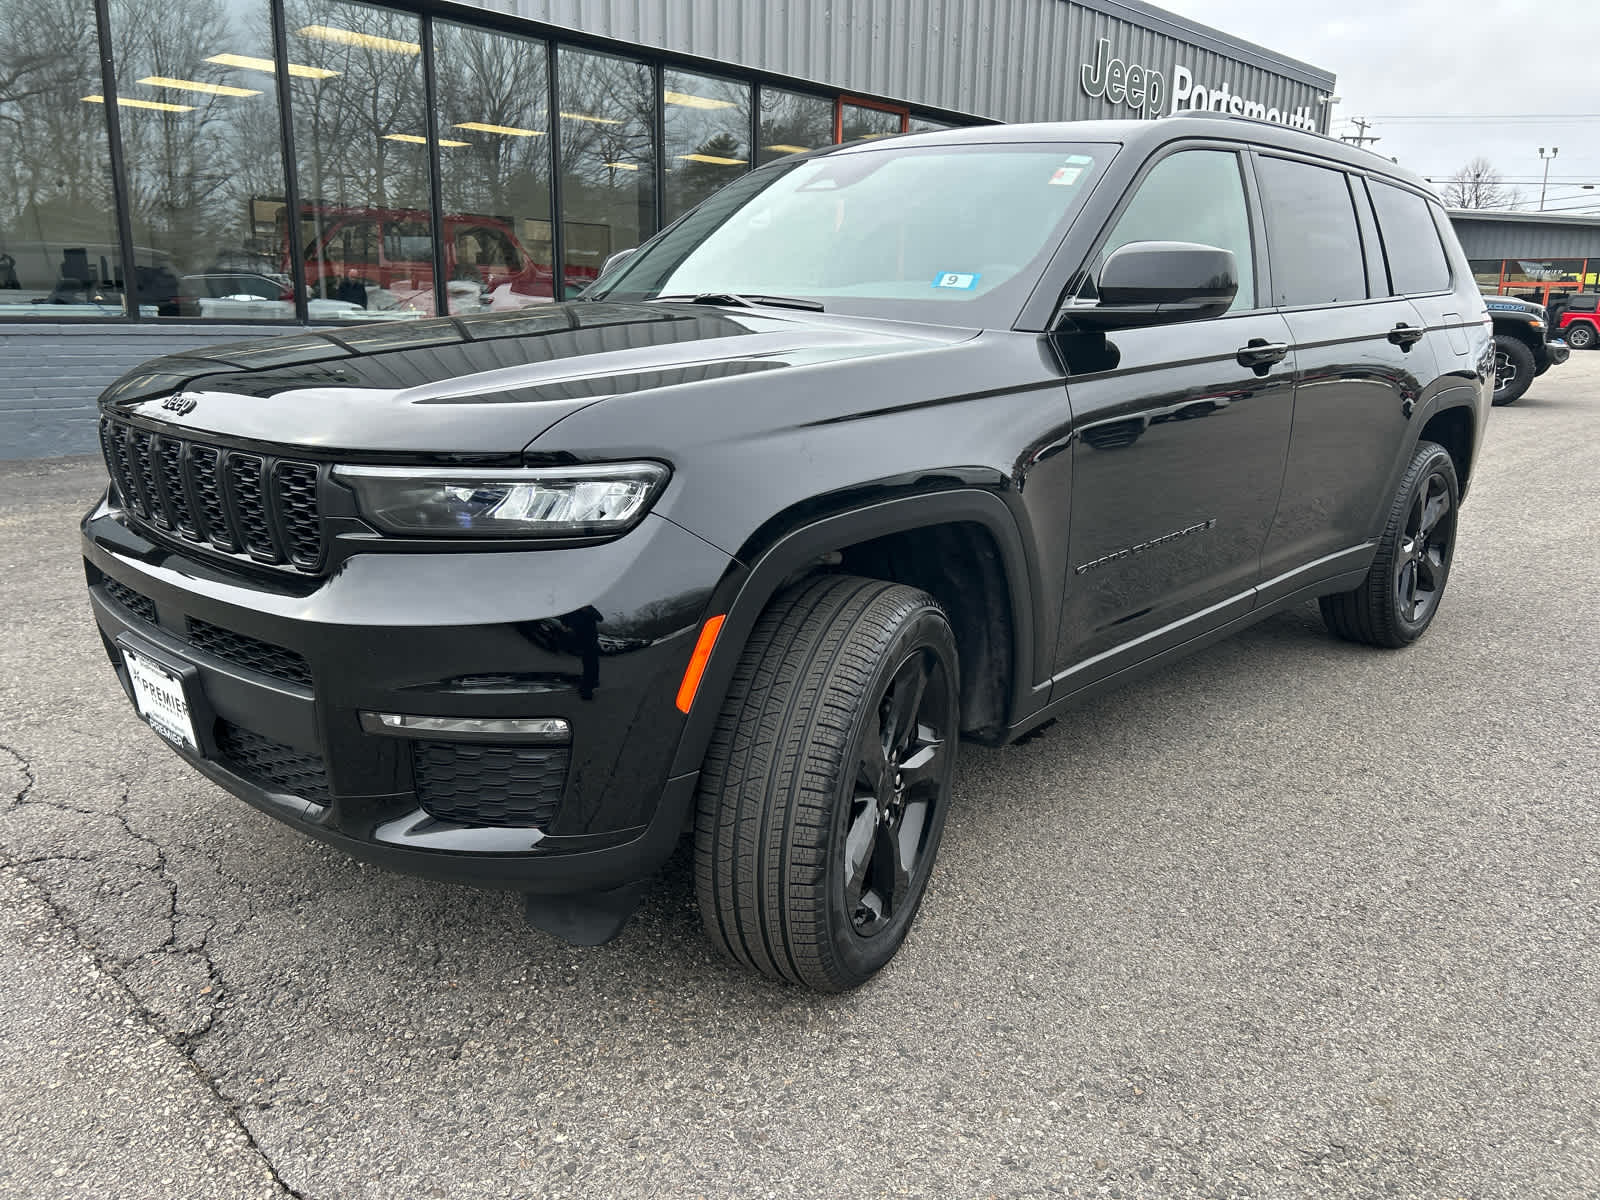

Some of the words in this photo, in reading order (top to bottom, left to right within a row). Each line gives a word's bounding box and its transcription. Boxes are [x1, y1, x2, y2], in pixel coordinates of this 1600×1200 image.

[1082, 38, 1165, 119] Jeep
[1171, 64, 1316, 132] Portsmouth
[946, 274, 959, 285] 9
[162, 391, 197, 416] Jeep
[142, 679, 187, 713] PREMIER
